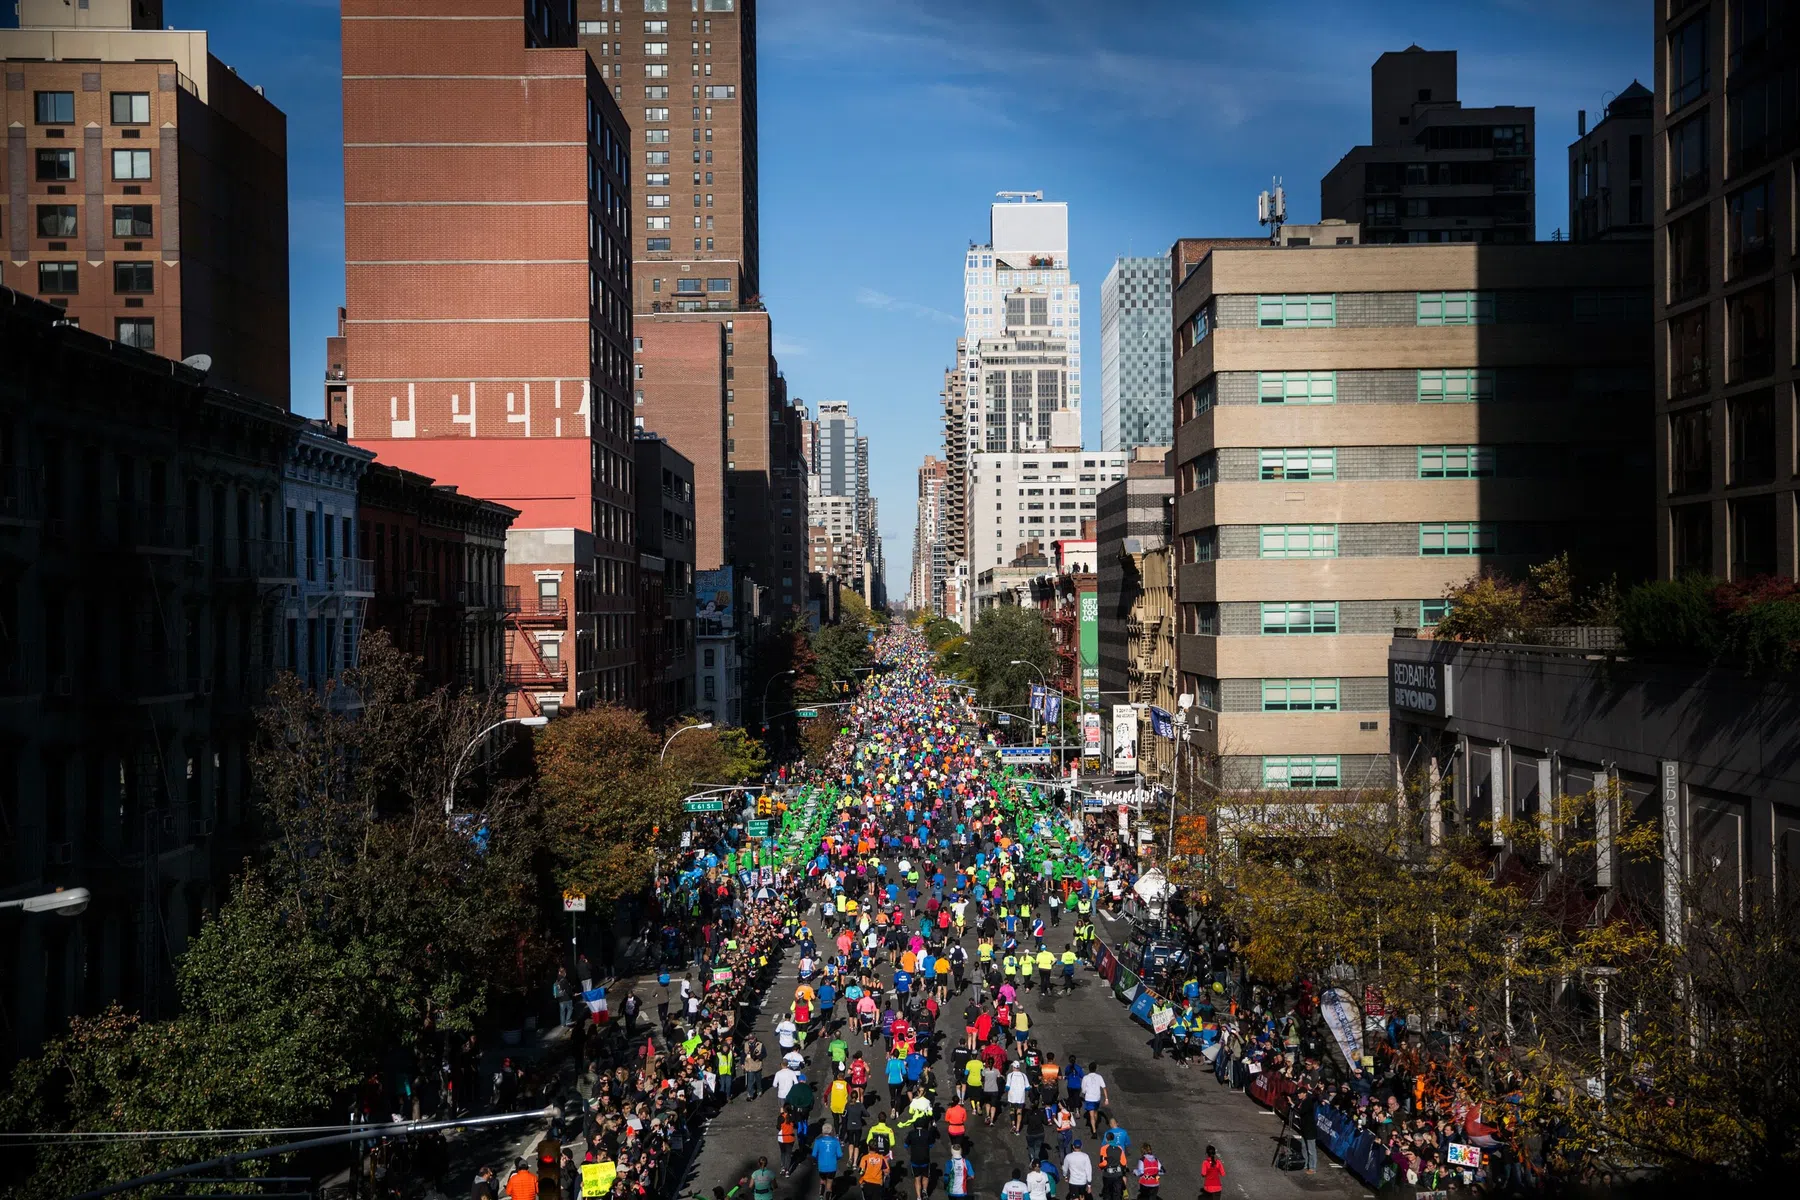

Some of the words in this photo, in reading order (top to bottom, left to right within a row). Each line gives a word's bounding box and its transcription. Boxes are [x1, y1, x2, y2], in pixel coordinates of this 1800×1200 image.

[1394, 663, 1408, 684] BED
[1409, 665, 1428, 688] BATH
[1429, 667, 1436, 689] &
[1395, 688, 1436, 711] BEYOND
[1666, 765, 1676, 800] BED
[1667, 806, 1677, 854] BATH
